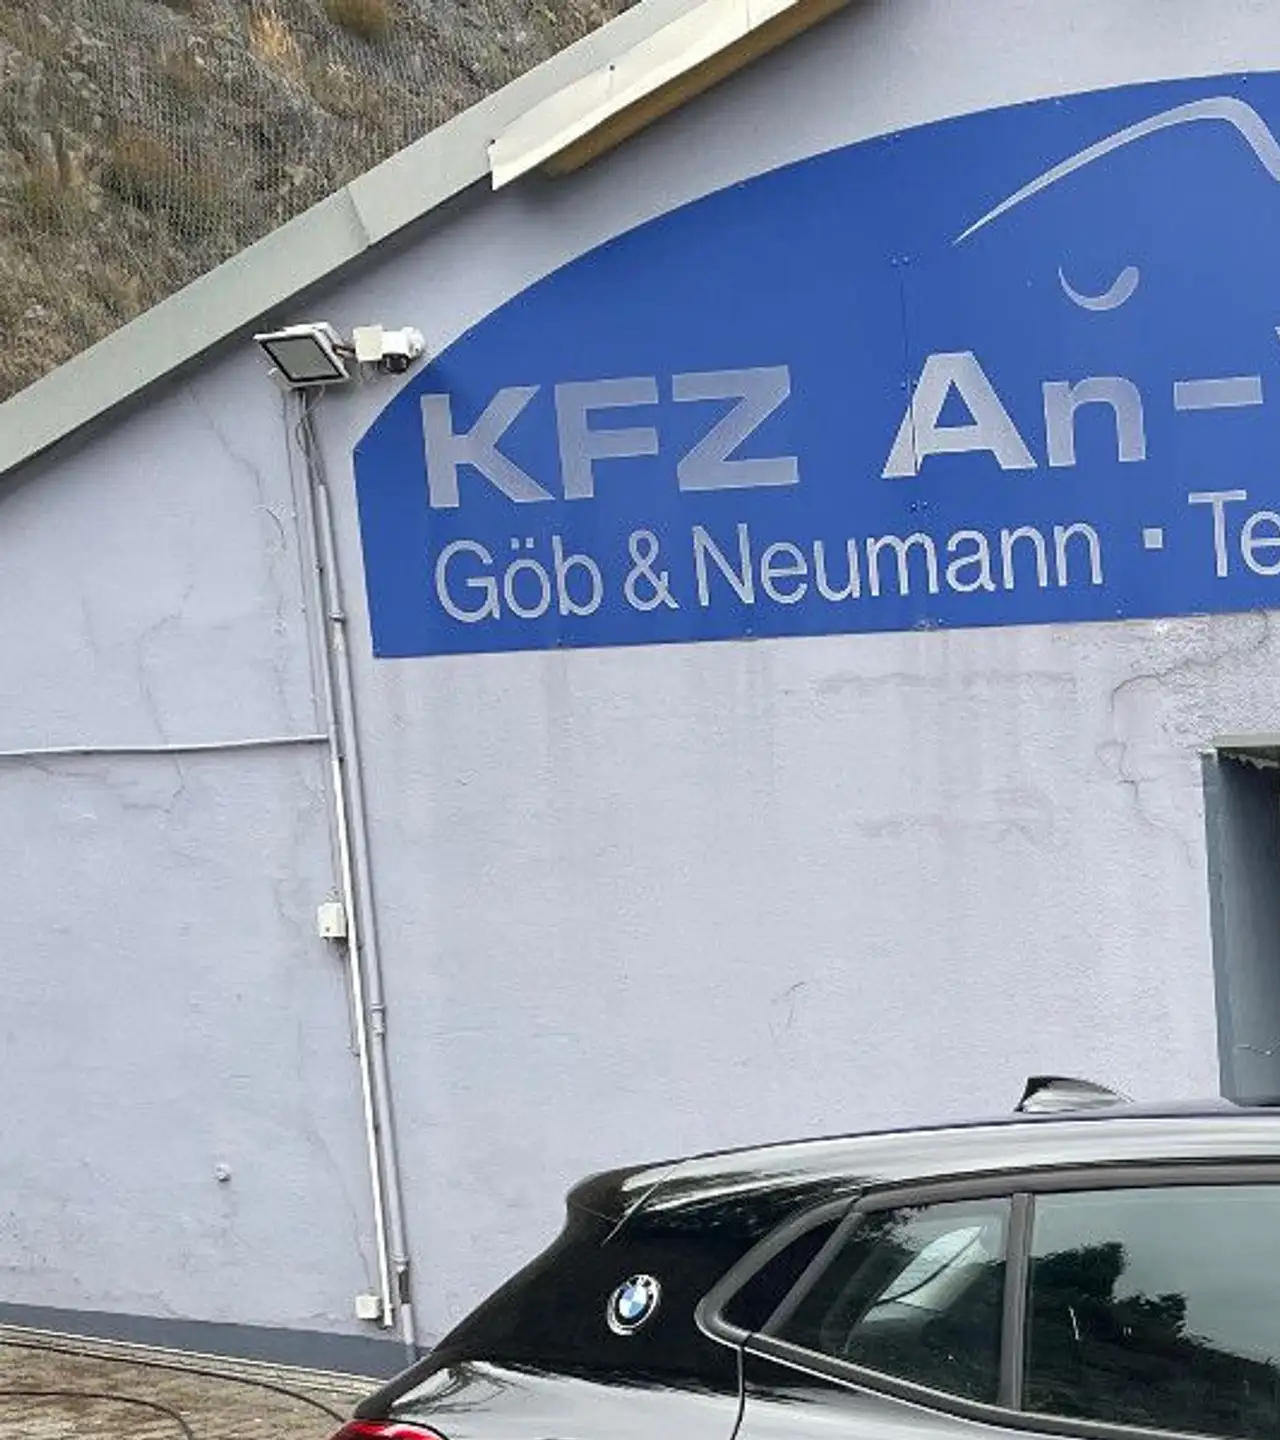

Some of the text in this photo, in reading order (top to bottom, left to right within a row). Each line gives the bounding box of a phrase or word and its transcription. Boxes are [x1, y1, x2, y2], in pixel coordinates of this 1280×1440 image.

[420, 365, 801, 511] KFZ
[435, 534, 603, 624] Göb
[623, 530, 681, 612] &
[692, 520, 1104, 608] Neumann
